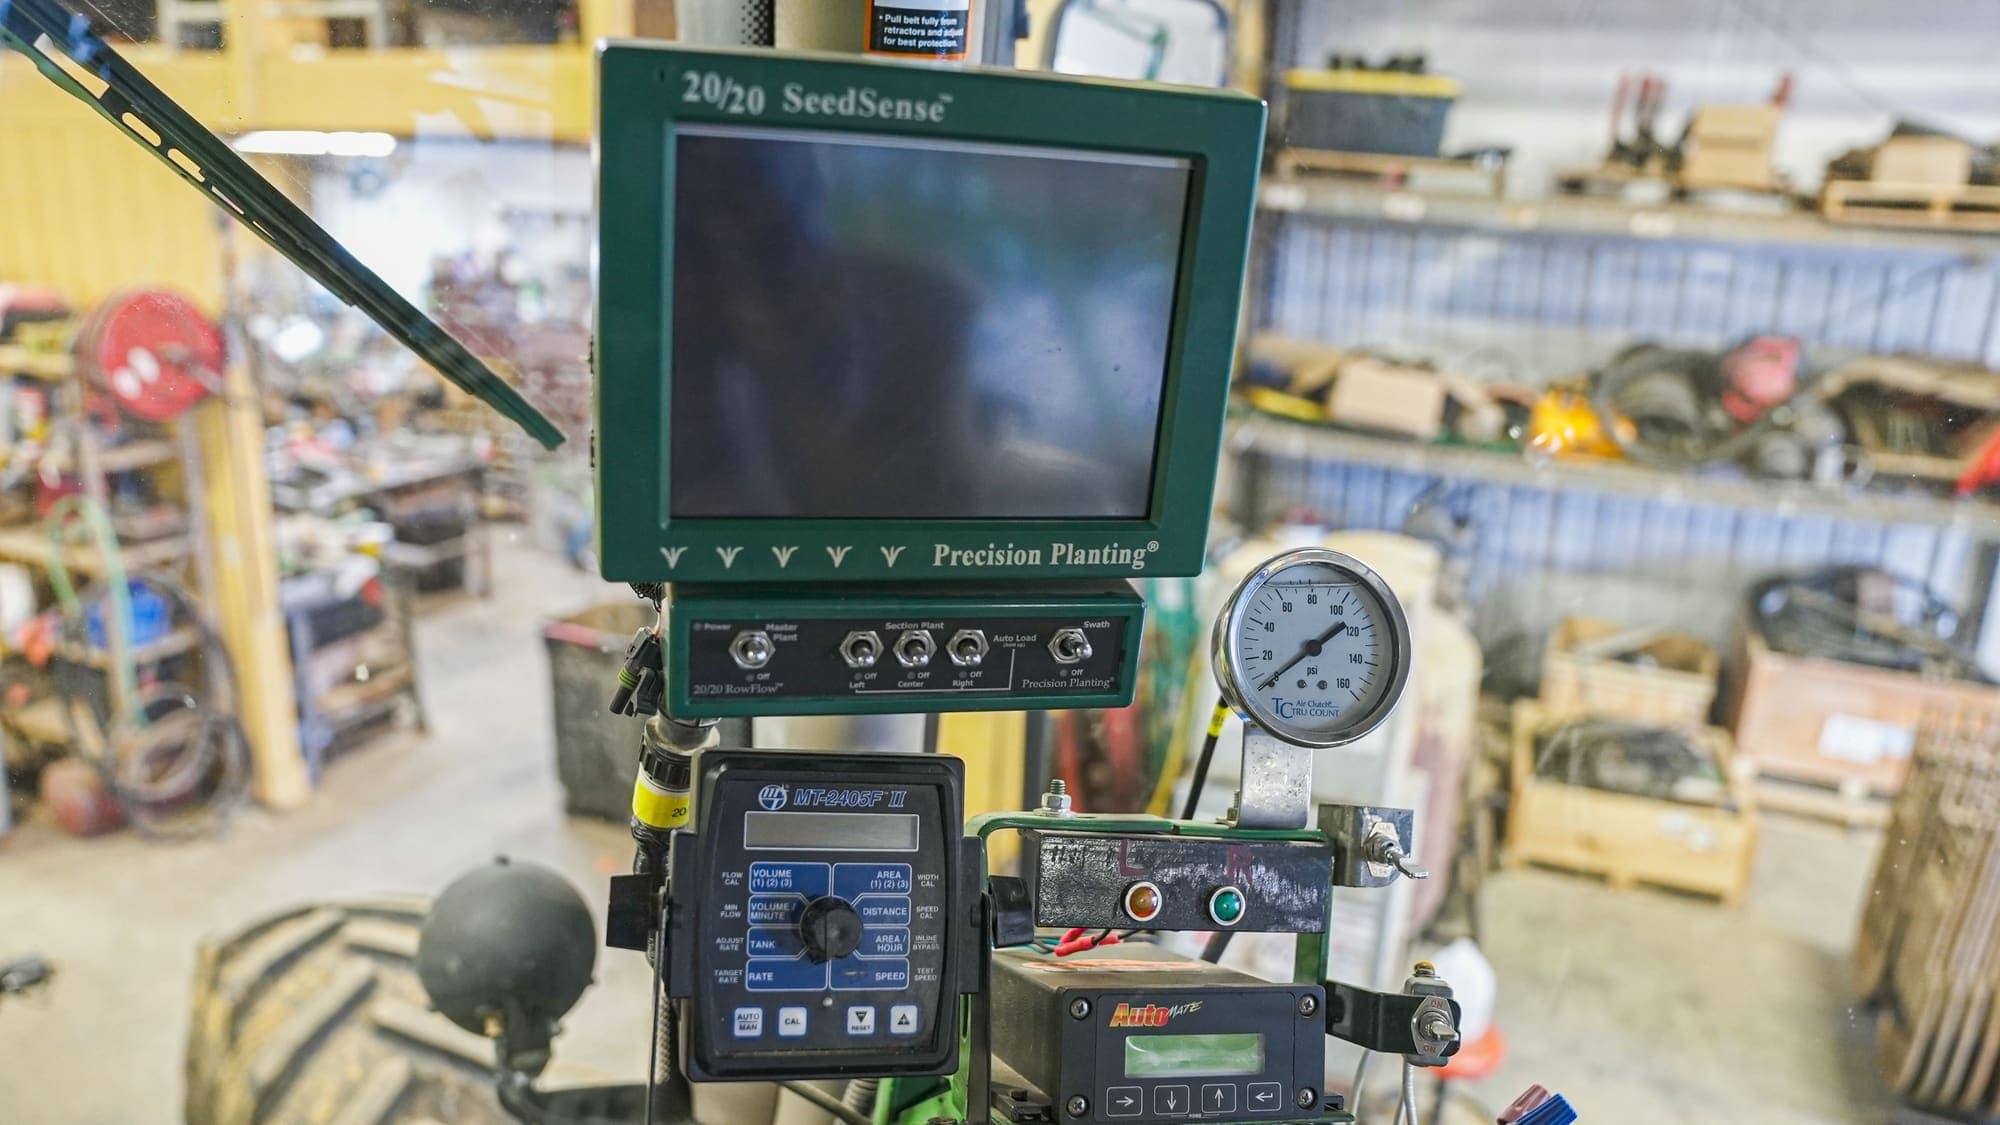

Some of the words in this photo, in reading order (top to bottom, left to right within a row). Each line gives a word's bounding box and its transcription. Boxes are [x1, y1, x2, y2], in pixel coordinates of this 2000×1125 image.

[884, 14, 902, 24] Pull
[904, 16, 920, 24] belt
[922, 16, 940, 26] fully
[884, 26, 926, 36] retractors
[928, 28, 942, 37] and
[884, 37, 896, 45] for
[898, 38, 916, 46] best
[918, 40, 958, 48] protection.
[682, 70, 766, 116] 20/20
[932, 543, 1041, 567] Precision
[1307, 594, 1317, 605] 80
[1282, 602, 1292, 612] 60
[1330, 605, 1343, 615] 100
[766, 623, 798, 631] Master
[885, 622, 918, 630] Section
[921, 622, 944, 630] Plant
[1084, 620, 1110, 628] Swath
[1264, 622, 1274, 632] 40
[1346, 626, 1359, 636] 120
[773, 633, 798, 641] Plant
[993, 634, 1014, 642] Auto
[1016, 634, 1036, 642] Load
[1262, 650, 1272, 660] 20
[1349, 654, 1362, 664] 140
[1071, 668, 1084, 676] Off
[1307, 666, 1318, 675] psi
[756, 672, 770, 680] Off
[864, 672, 877, 680] Off
[898, 680, 924, 688] Center
[952, 680, 974, 688] Right
[1022, 680, 1067, 688] Precision
[1336, 679, 1350, 689] 160
[694, 684, 722, 694] 20/20
[1272, 697, 1294, 719] TC
[1292, 707, 1307, 717] TRU
[1309, 709, 1339, 717] COUNT
[672, 808, 687, 818] 20
[753, 870, 792, 878] VOLUME
[752, 879, 764, 888] (1)
[766, 879, 778, 888] (2)
[780, 879, 792, 888] (3)
[870, 880, 881, 889] (1)
[884, 880, 894, 889] (2)
[897, 880, 908, 889] (3)
[752, 902, 790, 910] VOLUME
[750, 912, 785, 920] MINUTE
[863, 908, 908, 916] DISTANCE
[751, 941, 775, 949] TANK
[878, 944, 904, 952] HOUR
[749, 973, 773, 981] RATE
[876, 972, 905, 980] SPEED
[737, 1013, 759, 1021] AUTO
